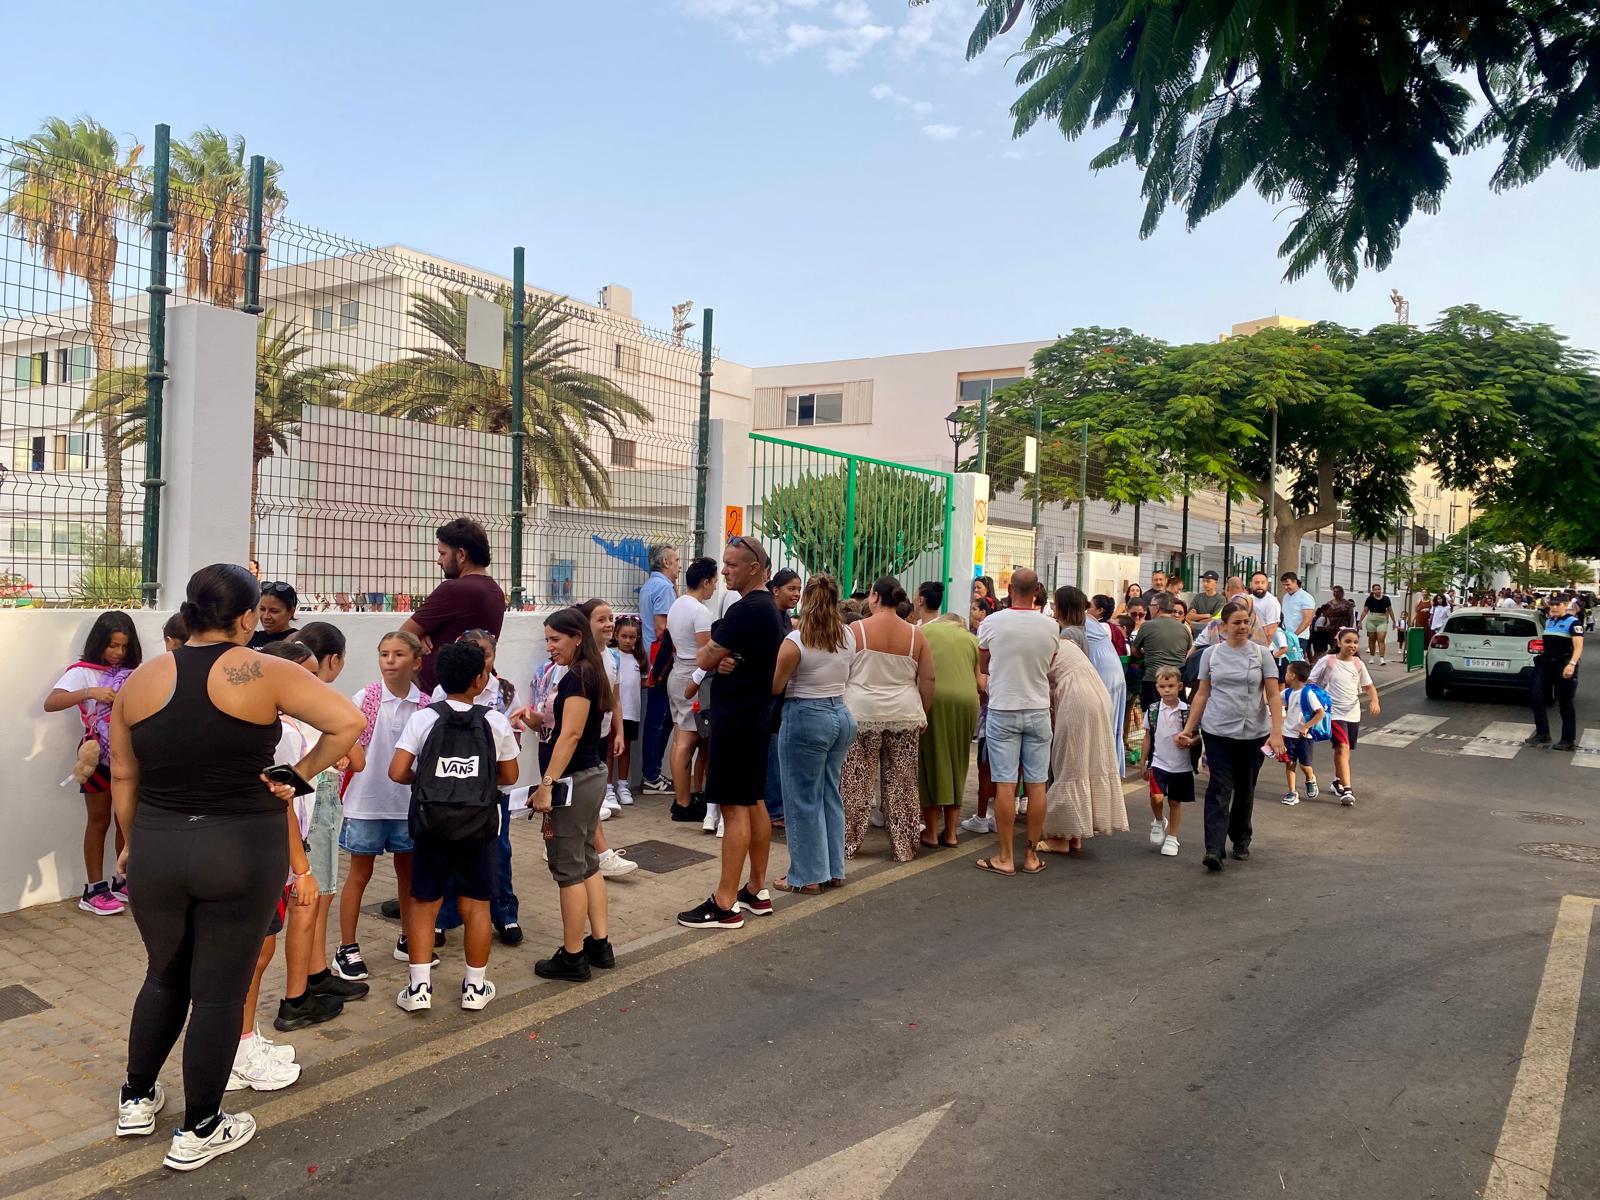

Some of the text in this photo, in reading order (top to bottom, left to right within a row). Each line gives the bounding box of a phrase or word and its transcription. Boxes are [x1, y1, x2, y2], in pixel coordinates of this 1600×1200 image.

[422, 261, 467, 285] COLEGIO
[471, 274, 512, 297] PUBLIO
[441, 759, 475, 775] VANS
[222, 1126, 232, 1140] K
